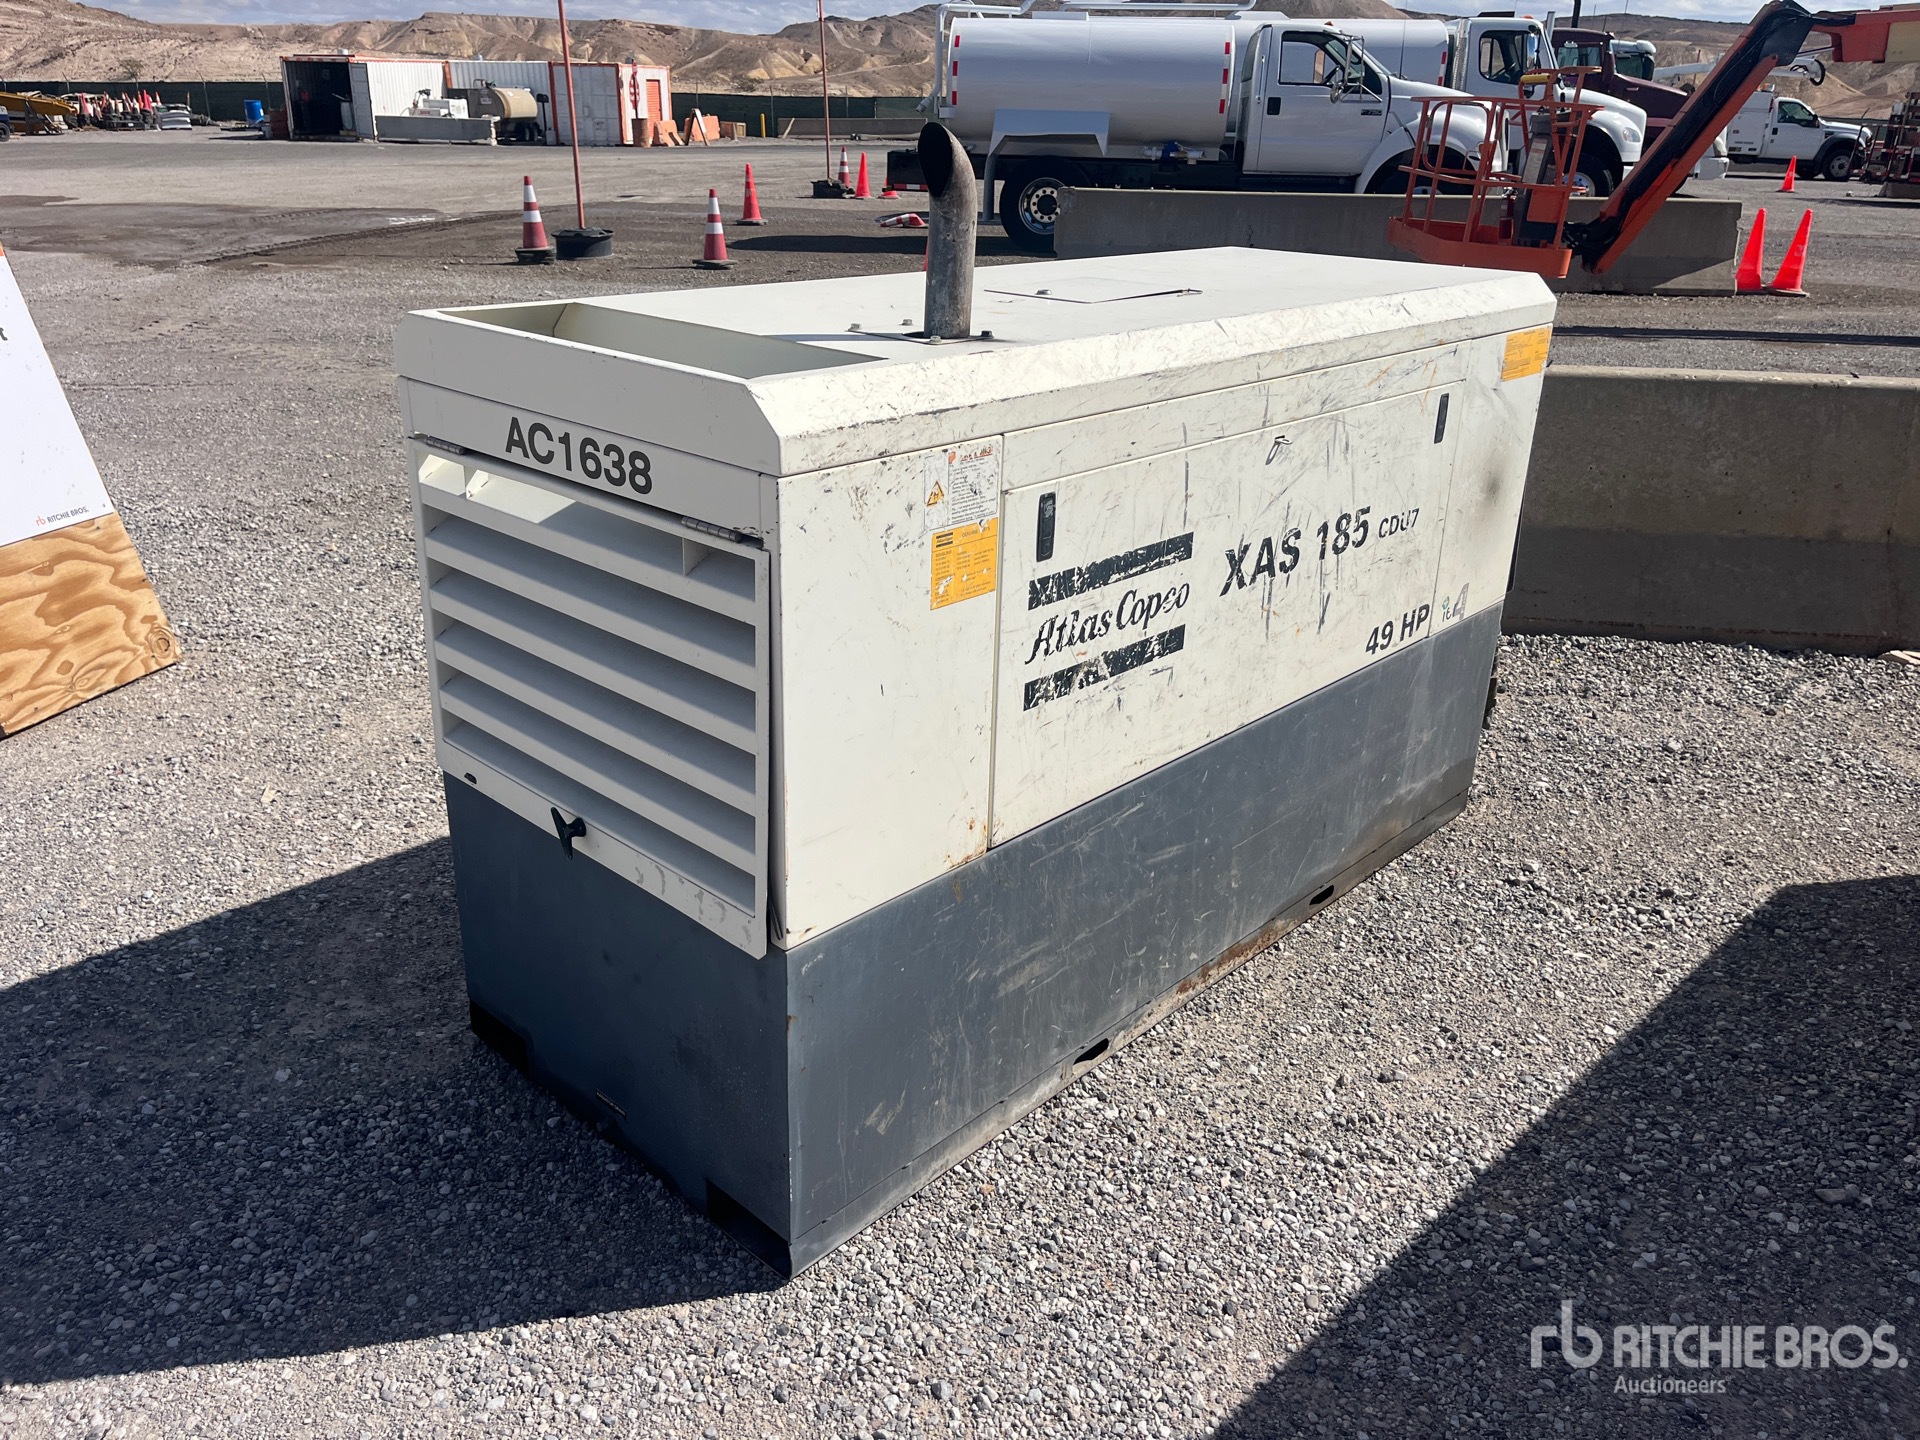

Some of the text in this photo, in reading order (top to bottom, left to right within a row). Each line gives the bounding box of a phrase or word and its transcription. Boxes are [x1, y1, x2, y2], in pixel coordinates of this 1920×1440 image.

[505, 416, 653, 495] AC1638
[46, 510, 71, 523] RITCHIE
[70, 506, 89, 517] BROS.
[1219, 527, 1302, 598] XAS
[1316, 506, 1371, 561] 185
[1024, 582, 1191, 665] Atlas Copco
[1365, 603, 1430, 655] 49 HP
